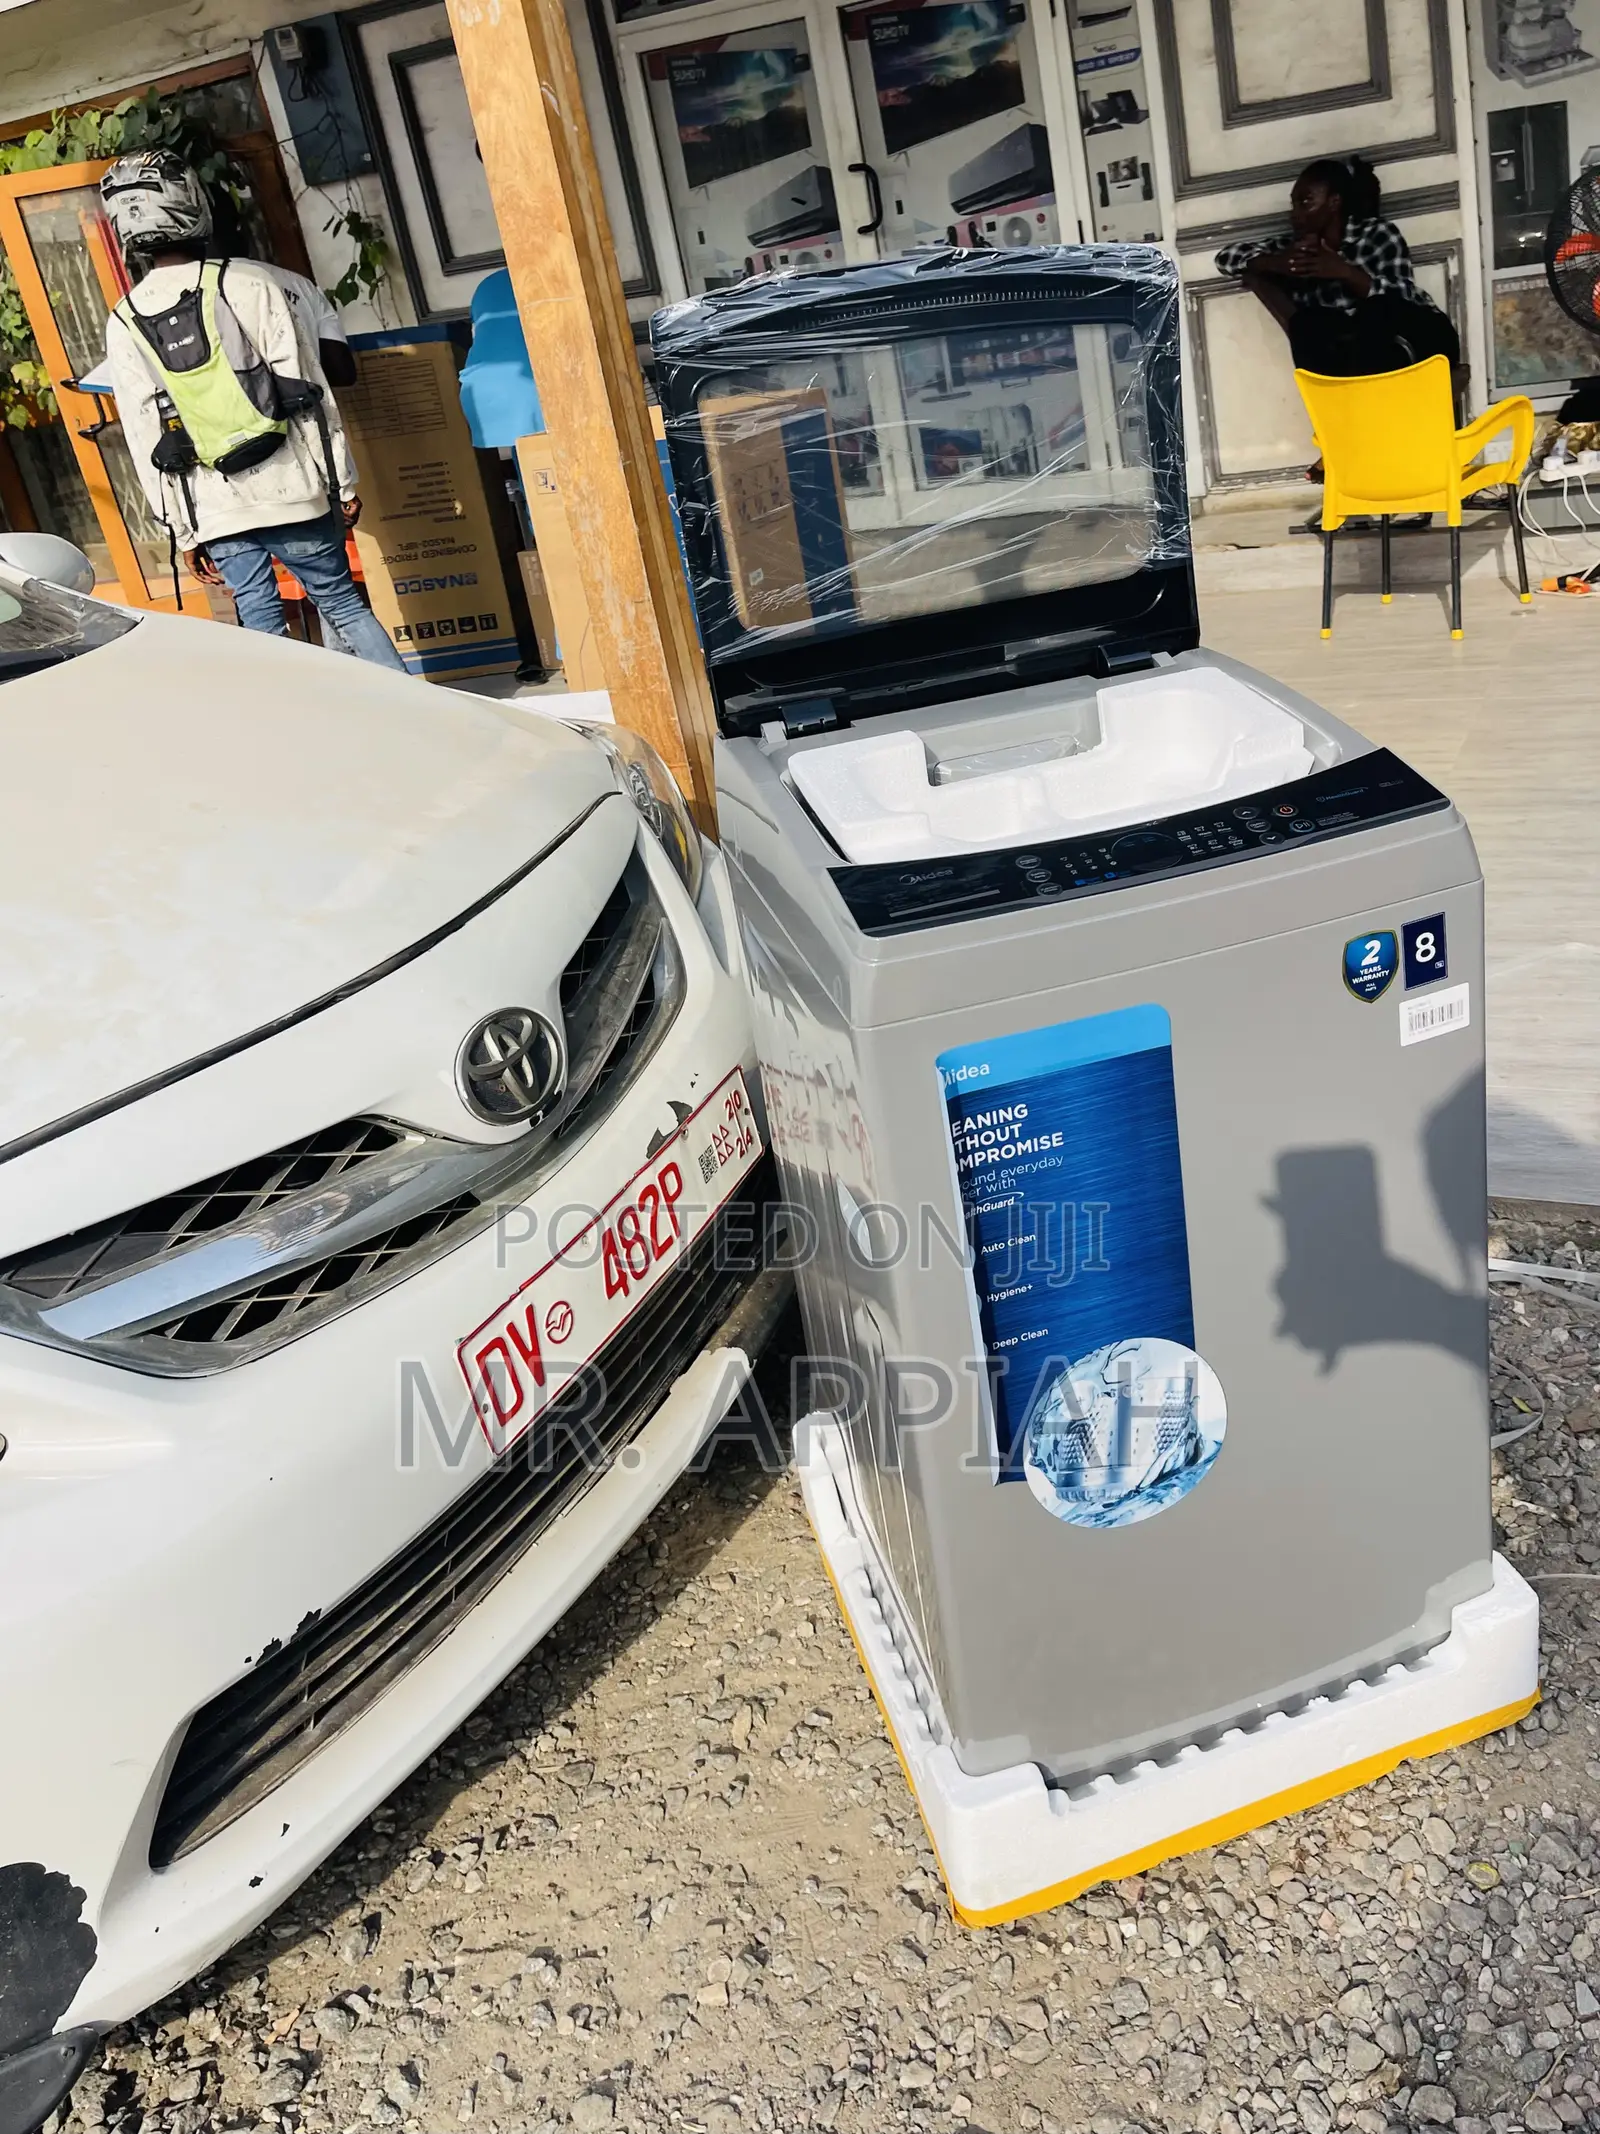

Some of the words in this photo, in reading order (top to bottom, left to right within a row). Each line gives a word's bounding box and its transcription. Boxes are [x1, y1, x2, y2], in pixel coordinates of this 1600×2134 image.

[380, 551, 420, 566] FRIDGE
[421, 543, 478, 559] COMBINED
[394, 574, 464, 596] NASCO
[901, 868, 954, 885] Midea
[1361, 939, 1382, 967] 2
[1415, 931, 1437, 963] 8
[1352, 969, 1390, 985] WARRANTY
[1359, 964, 1382, 976] YEARS
[1000, 1155, 1064, 1179] everyday
[986, 1177, 1017, 1193] with
[964, 1195, 1015, 1220] althGuard
[980, 1241, 1005, 1255] Auto
[1007, 1233, 1036, 1247] Clean
[475, 1303, 546, 1428] DV
[600, 1160, 685, 1301] 482P
[987, 1283, 1034, 1303] Hygiene+
[992, 1335, 1019, 1351] Deep
[1020, 1327, 1049, 1342] Clean
